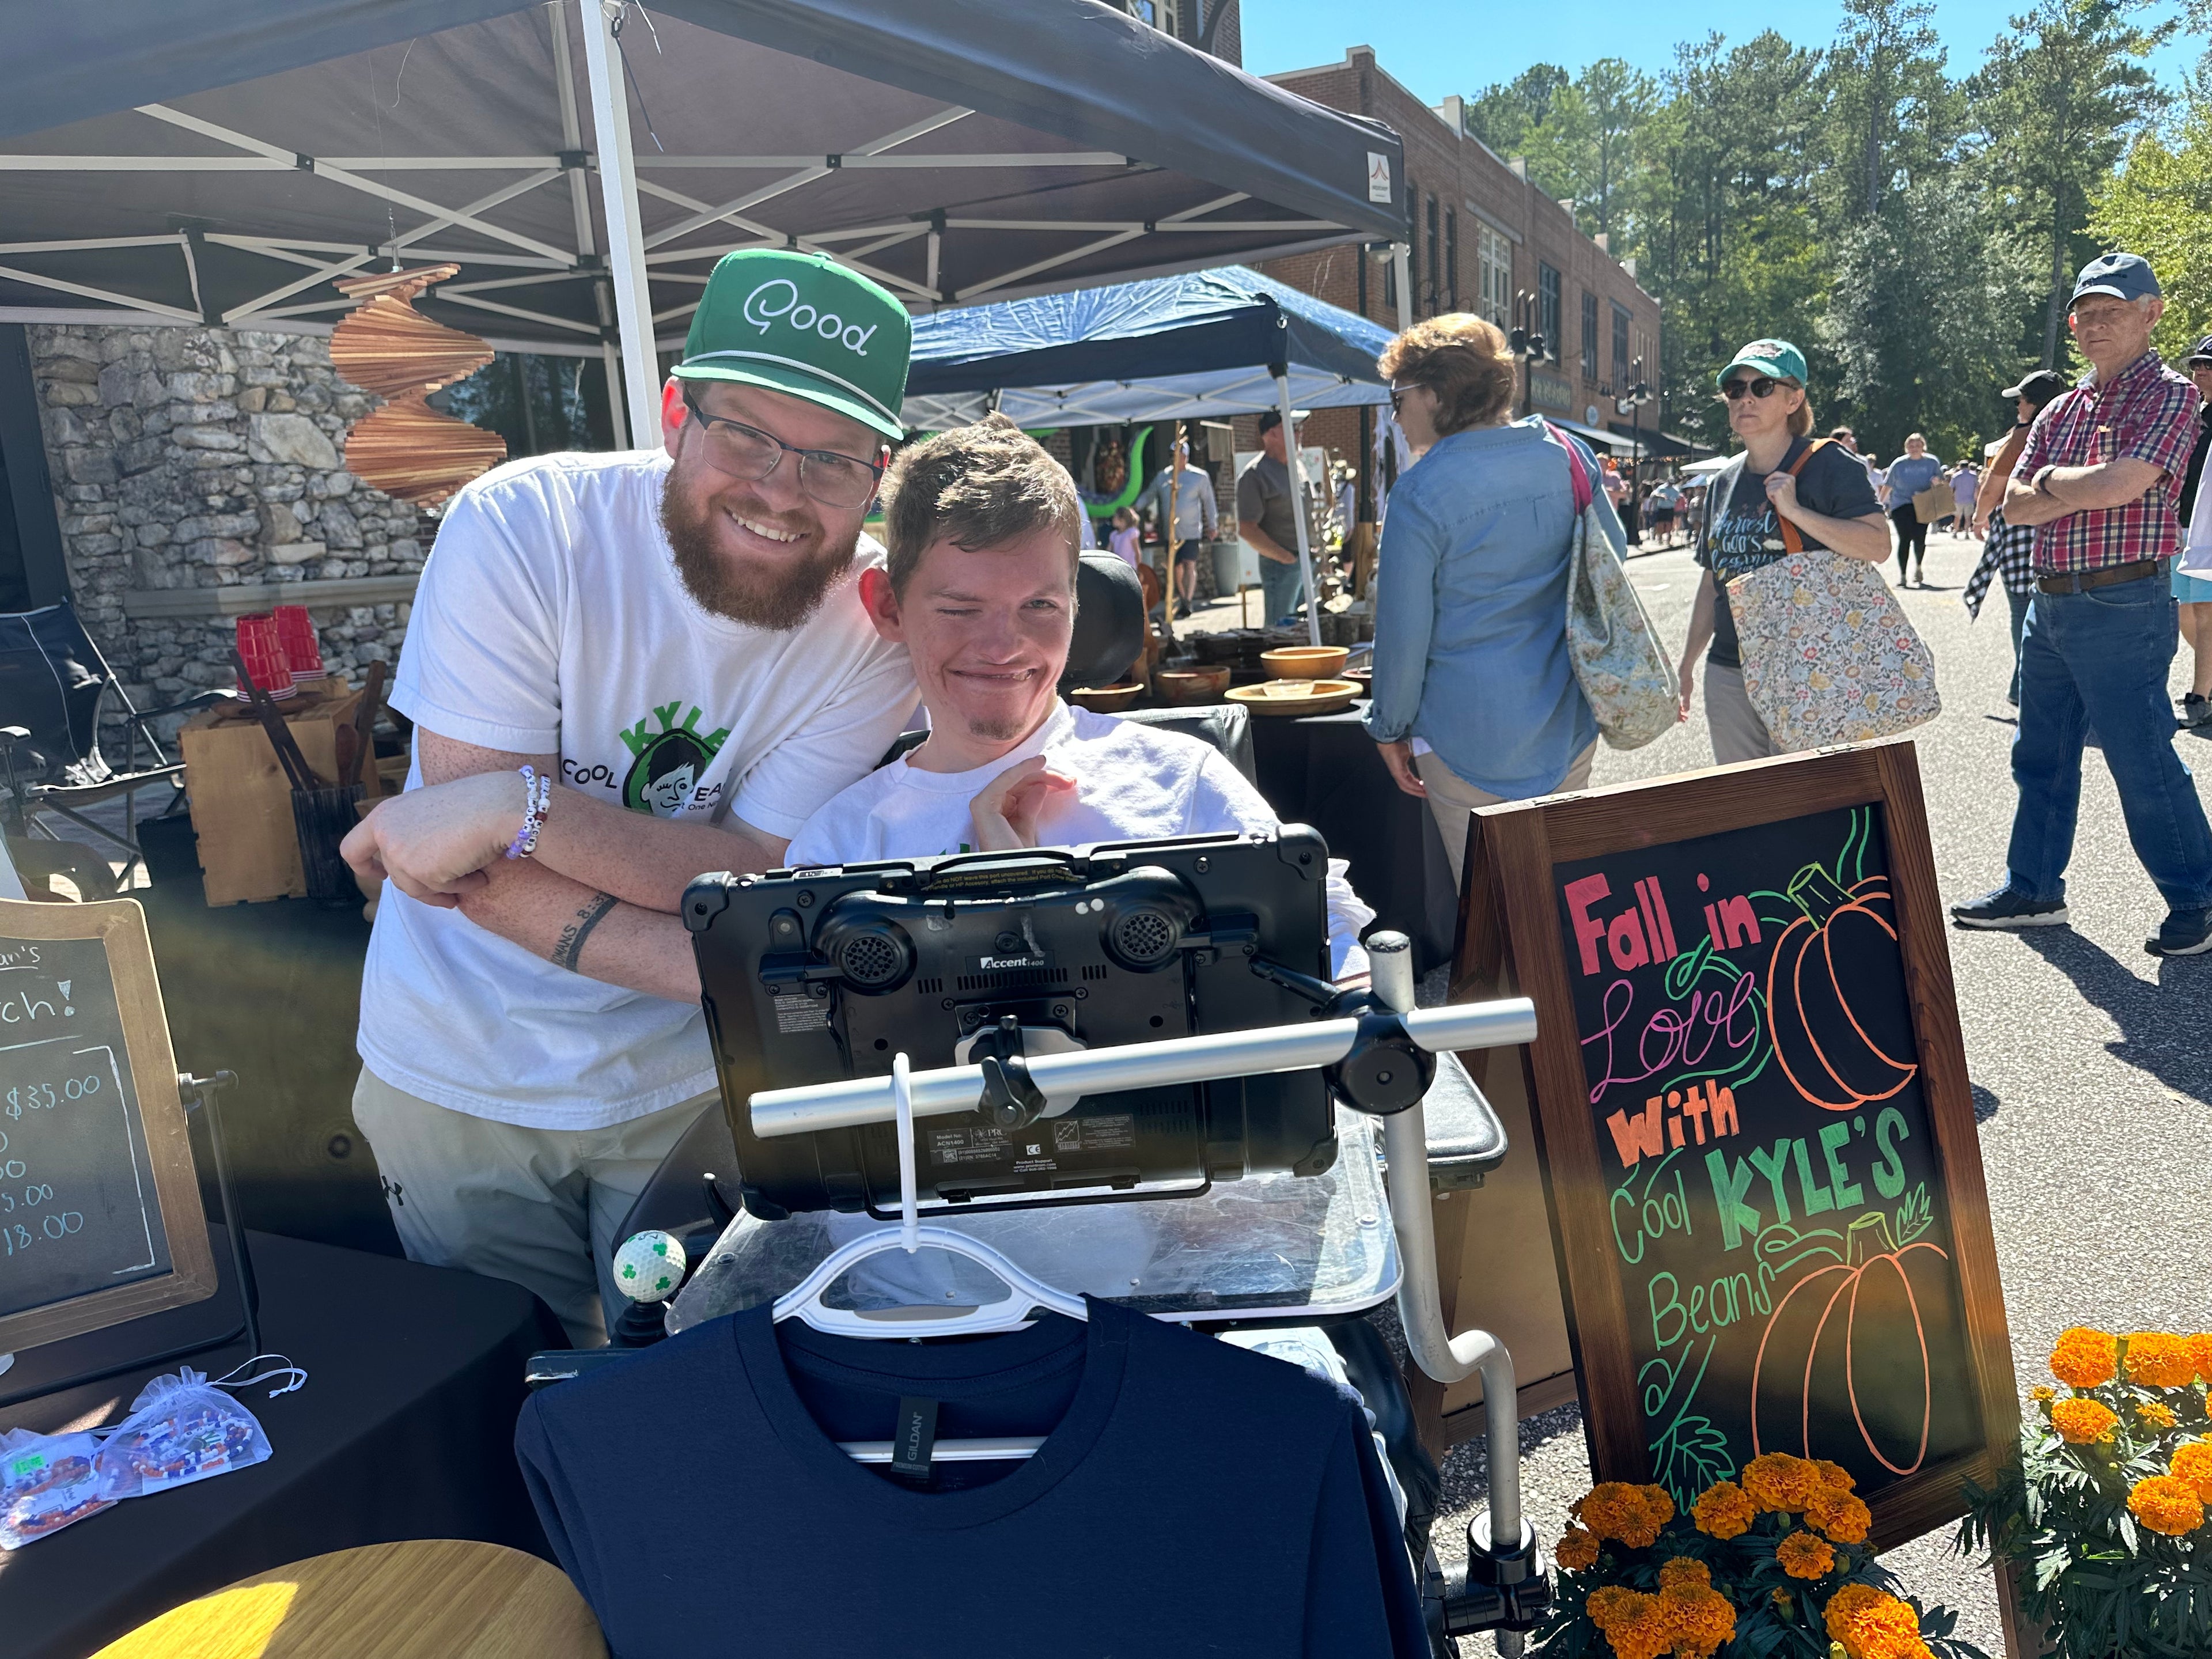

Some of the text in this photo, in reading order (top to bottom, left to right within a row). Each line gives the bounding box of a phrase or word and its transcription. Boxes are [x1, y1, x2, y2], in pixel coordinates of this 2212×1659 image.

[744, 279, 877, 357] Good
[563, 759, 617, 789] COOL
[980, 957, 1027, 968] Accent
[1564, 873, 1762, 976] Fall in
[0, 979, 75, 1023] ch!
[1581, 972, 1755, 1104] Love
[6, 1075, 100, 1120] $35.00
[1610, 1169, 1692, 1264] Cool
[1705, 1107, 1910, 1251] KYLE'S
[1648, 1262, 1775, 1351] Beans
[907, 1415, 923, 1461] GILDAN
